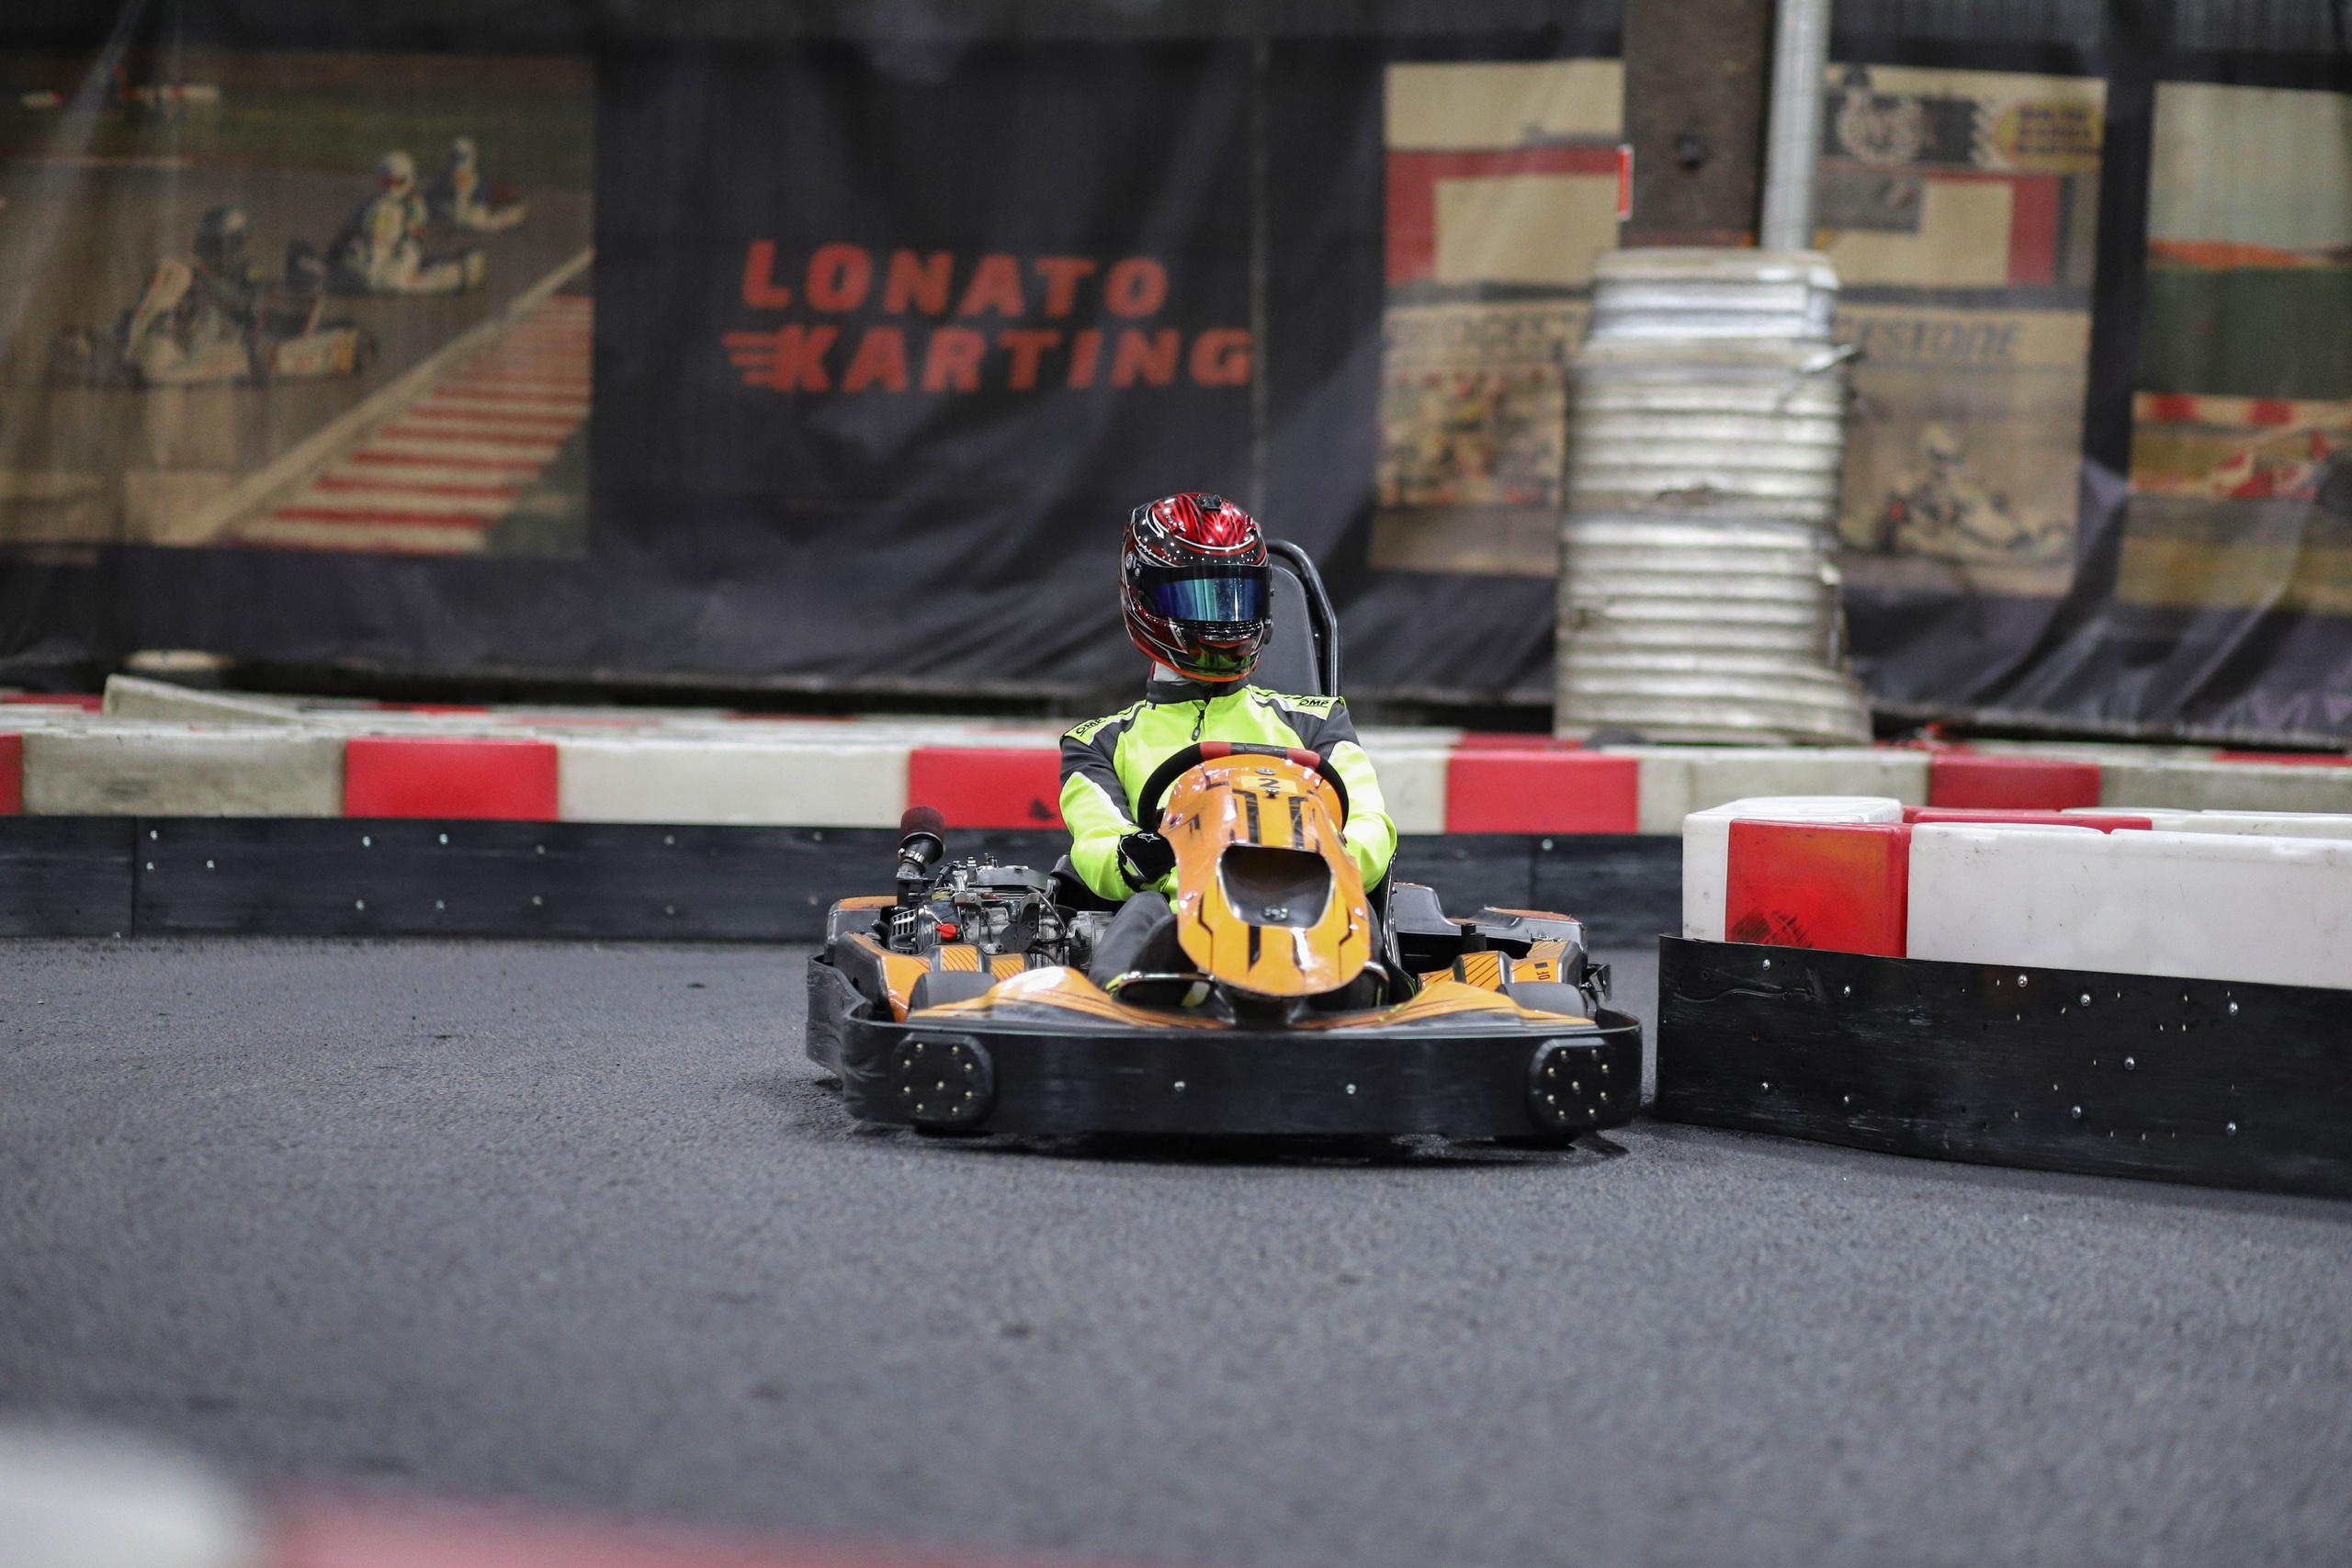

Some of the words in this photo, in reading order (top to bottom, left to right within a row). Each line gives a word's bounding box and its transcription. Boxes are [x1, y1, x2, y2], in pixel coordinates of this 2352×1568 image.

[741, 239, 1169, 317] LONATO
[766, 324, 1253, 393] KARTING
[1258, 778, 1281, 789] 2
